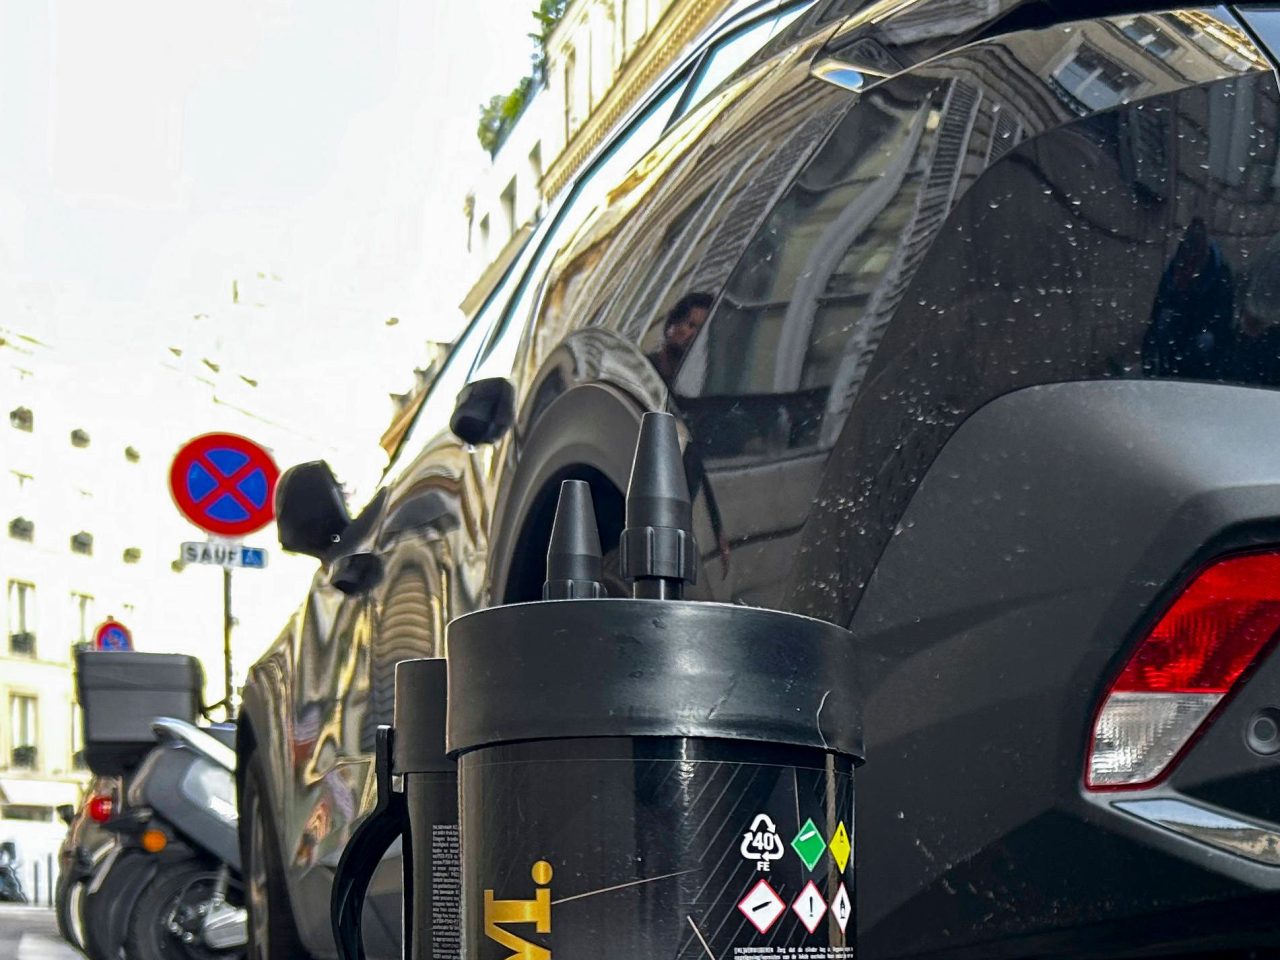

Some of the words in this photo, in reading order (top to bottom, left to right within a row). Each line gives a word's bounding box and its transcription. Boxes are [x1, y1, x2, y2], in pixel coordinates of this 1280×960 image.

[186, 546, 238, 564] SAUF
[751, 831, 774, 851] 40
[756, 861, 771, 872] FE
